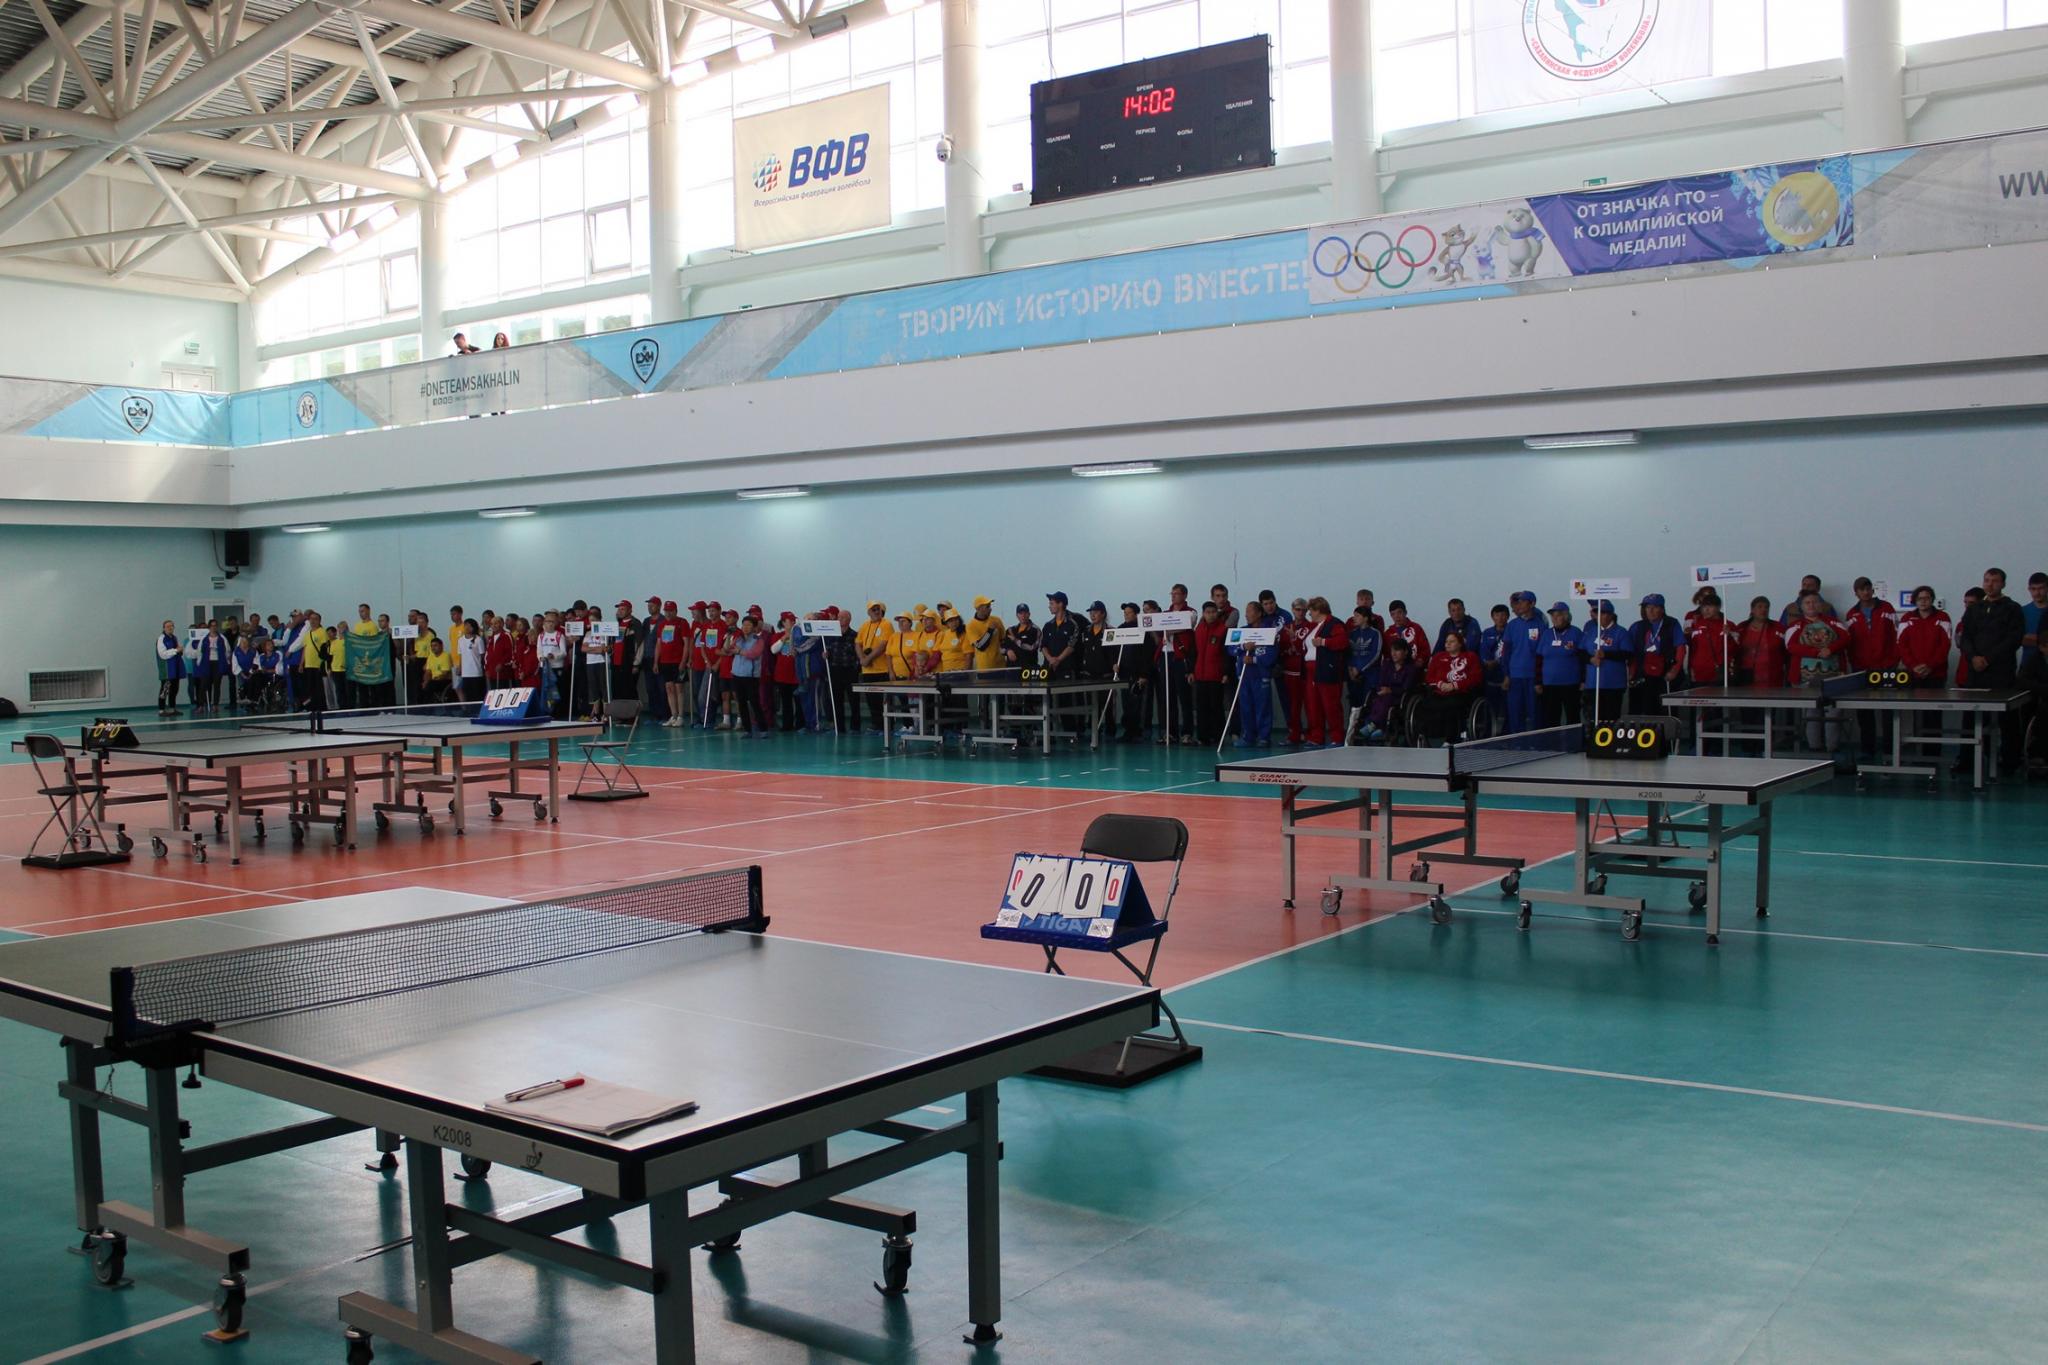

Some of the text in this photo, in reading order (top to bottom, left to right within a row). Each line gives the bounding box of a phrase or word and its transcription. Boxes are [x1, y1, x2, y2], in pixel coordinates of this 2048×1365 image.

[1123, 87, 1176, 118] 14:02
[788, 132, 870, 188] ВФВ
[1176, 164, 1182, 173] 3
[1112, 175, 1117, 184] 2
[1577, 202, 1598, 218] ОТ
[1602, 194, 1669, 216] ЗНАЧКА
[1675, 190, 1706, 206] ГТО
[1574, 207, 1724, 239] К ОЛИМПИЙСКОЙ
[1609, 234, 1687, 255] МЕДАЛИ!
[899, 299, 1003, 339] ТВОРИМ
[1016, 278, 1162, 323] ИСТОРИЮ
[420, 370, 520, 398] #ONETEAMSAKHALIN
[1869, 672, 1881, 684] 0
[1896, 672, 1909, 684] 0
[494, 693, 503, 707] 0
[510, 692, 519, 705] 0
[1594, 727, 1613, 747] 0
[1637, 728, 1656, 748] 0
[1021, 873, 1045, 907] 0
[1074, 873, 1094, 910] 0
[1107, 878, 1120, 902] 0
[432, 1125, 472, 1148] K2008
